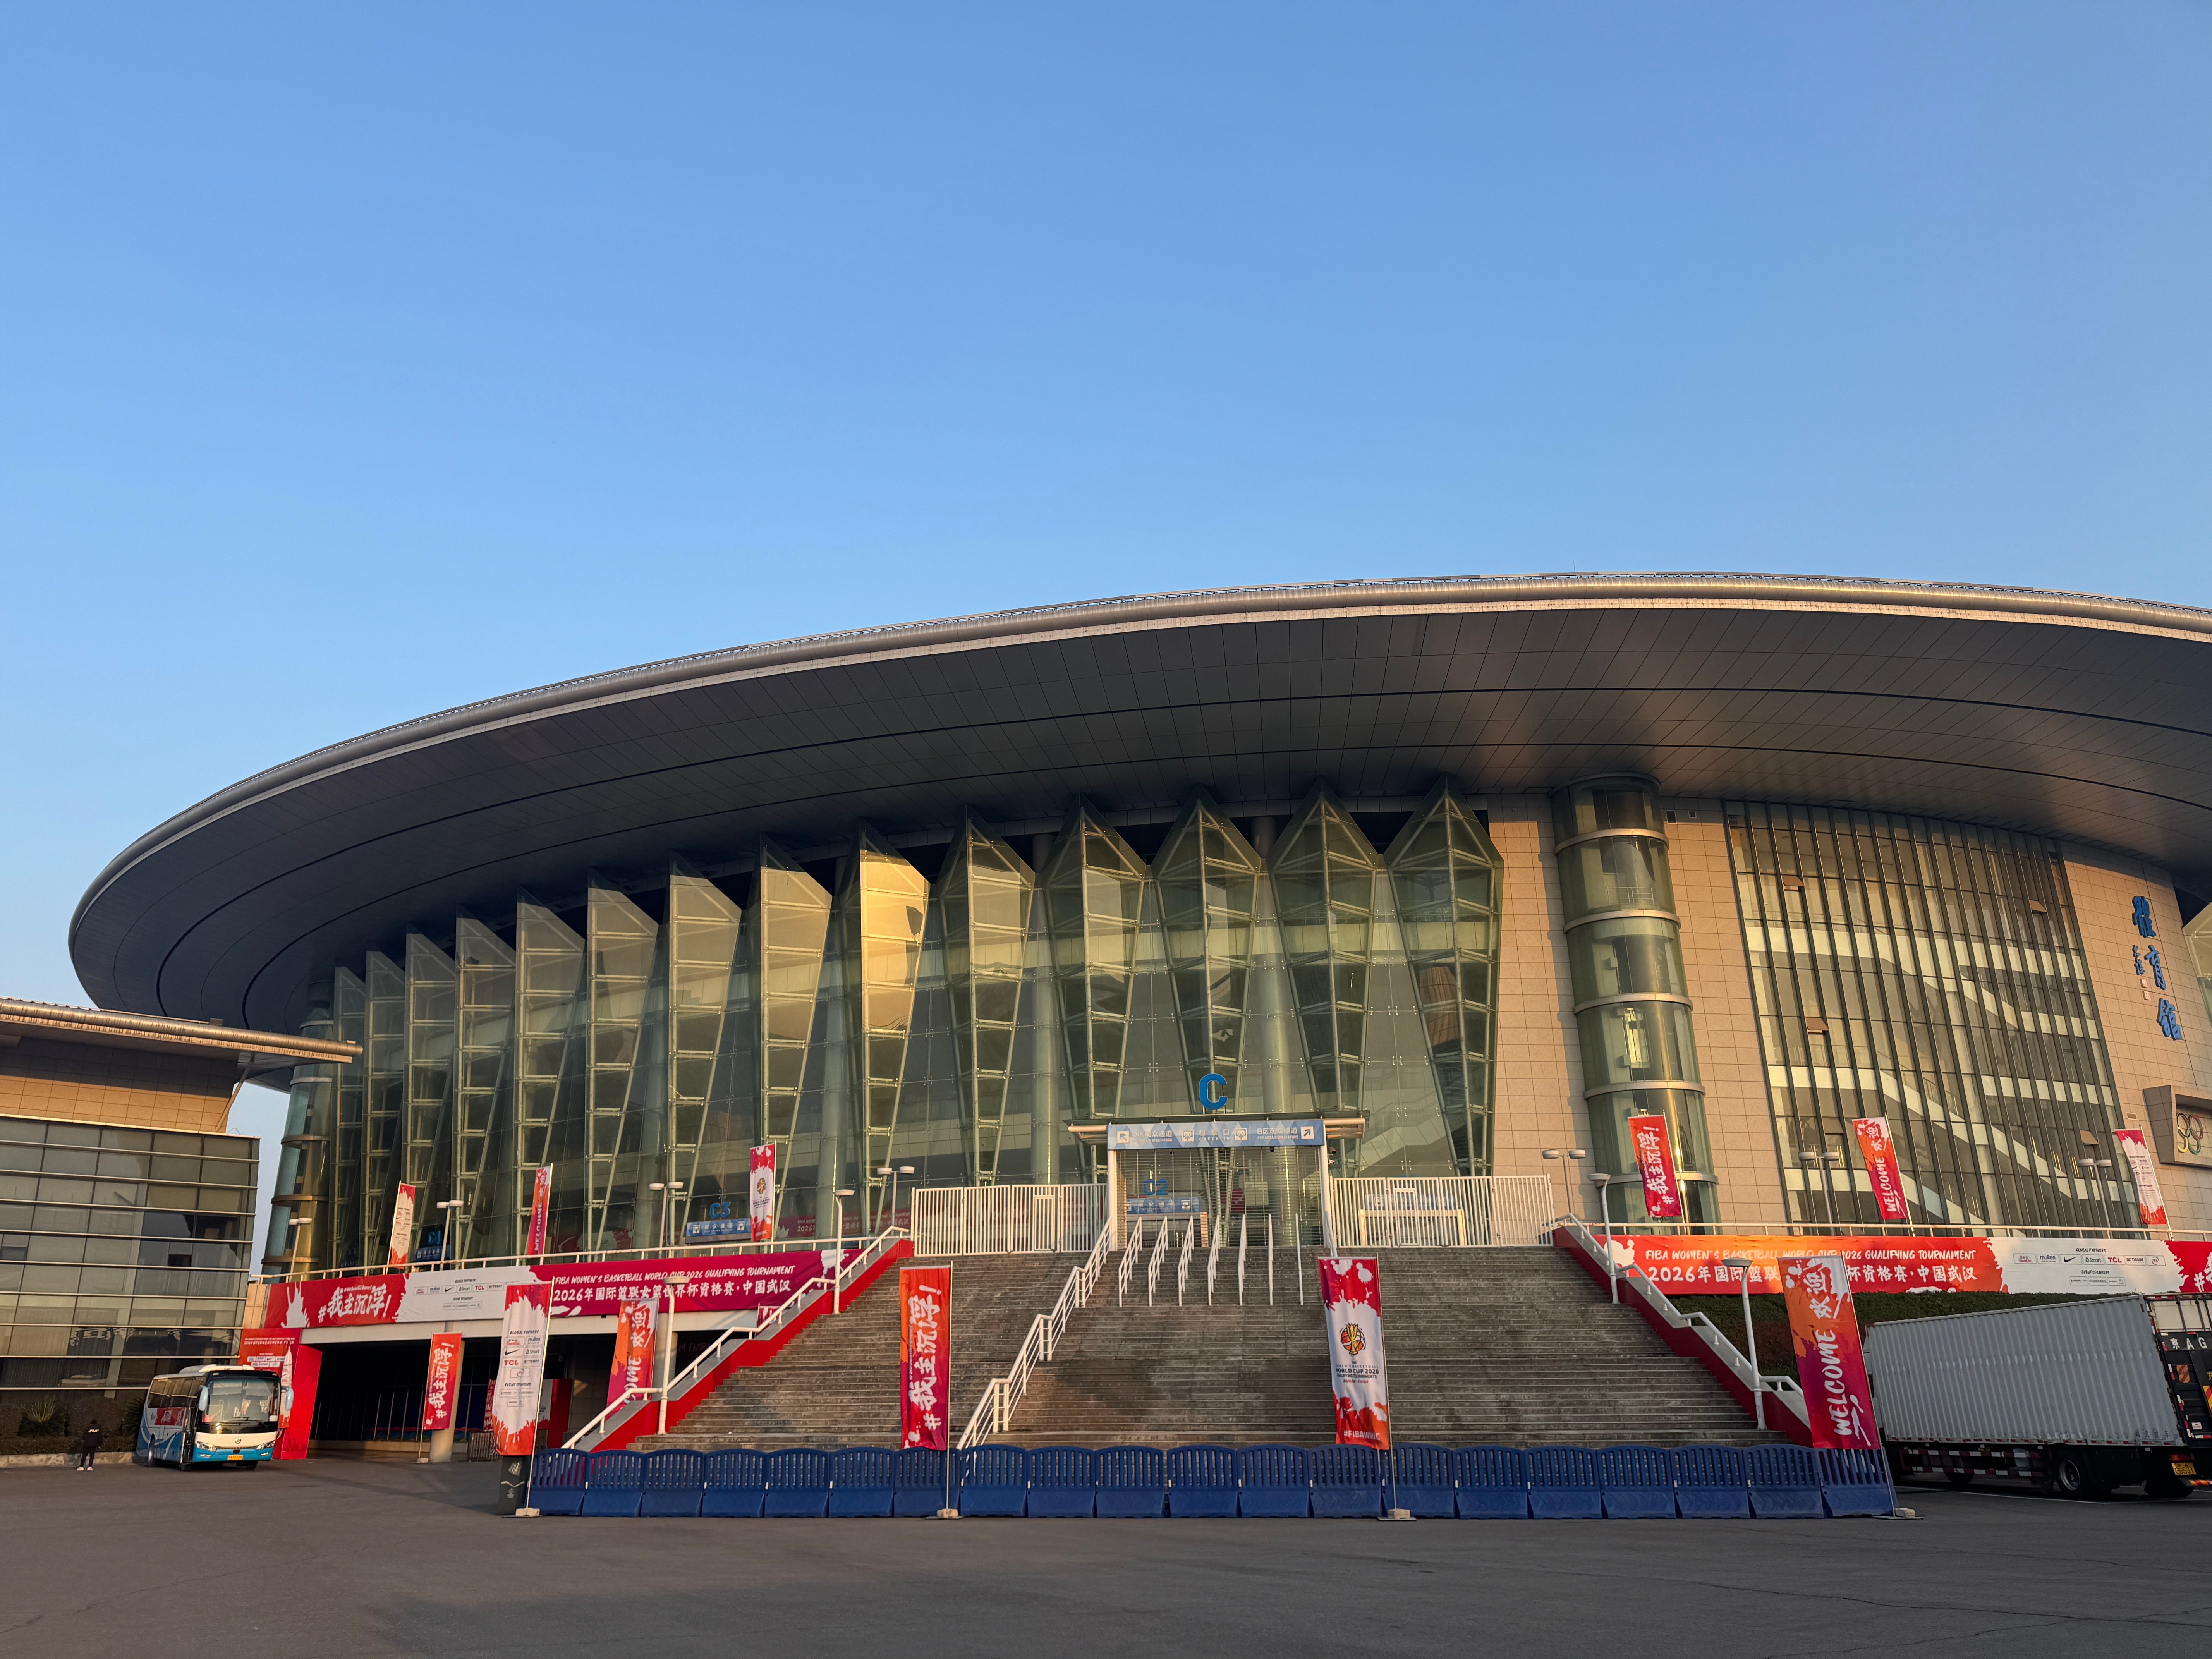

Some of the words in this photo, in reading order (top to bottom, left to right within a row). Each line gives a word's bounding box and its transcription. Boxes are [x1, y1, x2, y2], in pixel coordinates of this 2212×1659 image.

[1199, 1073, 1228, 1110] C
[1875, 1156, 1897, 1212] WELCOME
[709, 1202, 731, 1218] C3
[1645, 1250, 1668, 1260] FIBA
[1672, 1250, 1719, 1260] WOMEN'S
[1723, 1250, 1778, 1259] BASKETBALL
[1865, 1250, 1915, 1259] QUALIFYING
[1917, 1250, 1977, 1260] TOURNAMENT
[555, 1276, 569, 1285] FIBA
[604, 1273, 642, 1283] BASKETBALL
[644, 1271, 668, 1281] WORLD
[687, 1271, 703, 1279] 2026
[705, 1267, 745, 1278] QUALIFYING
[747, 1265, 796, 1276] TOURNAMENT
[1815, 1329, 1852, 1436] WELCOME
